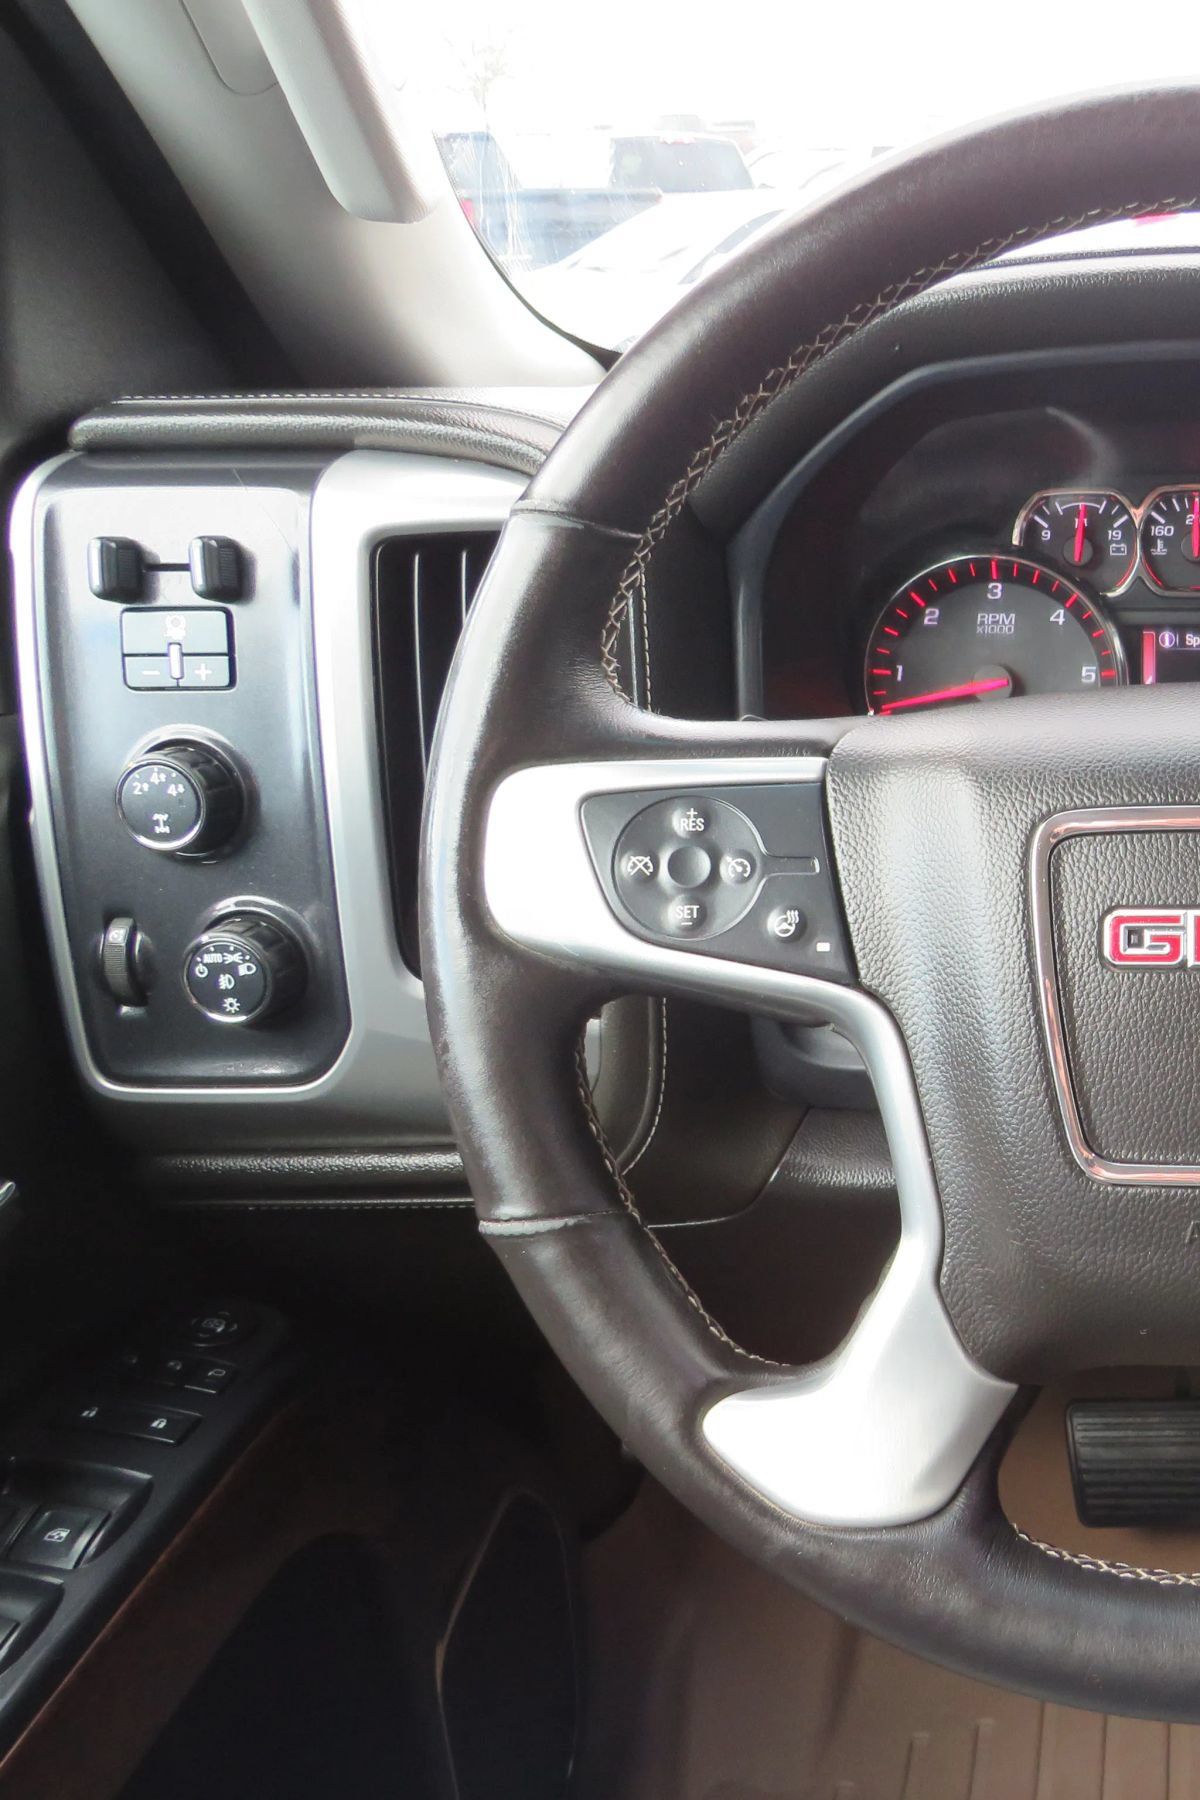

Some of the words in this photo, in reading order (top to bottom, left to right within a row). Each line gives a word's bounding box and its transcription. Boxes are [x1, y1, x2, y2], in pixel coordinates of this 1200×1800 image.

[1041, 530, 1051, 541] 9
[1107, 530, 1123, 541] 19
[1150, 526, 1175, 538] 160
[986, 582, 1003, 600] 3
[923, 608, 940, 626] 2
[976, 612, 1016, 625] RPM
[1049, 608, 1066, 626] 4
[896, 665, 903, 681] 1
[1081, 666, 1097, 683] 5
[680, 817, 705, 832] RES
[675, 905, 700, 919] SET
[203, 953, 223, 964] AUTO
